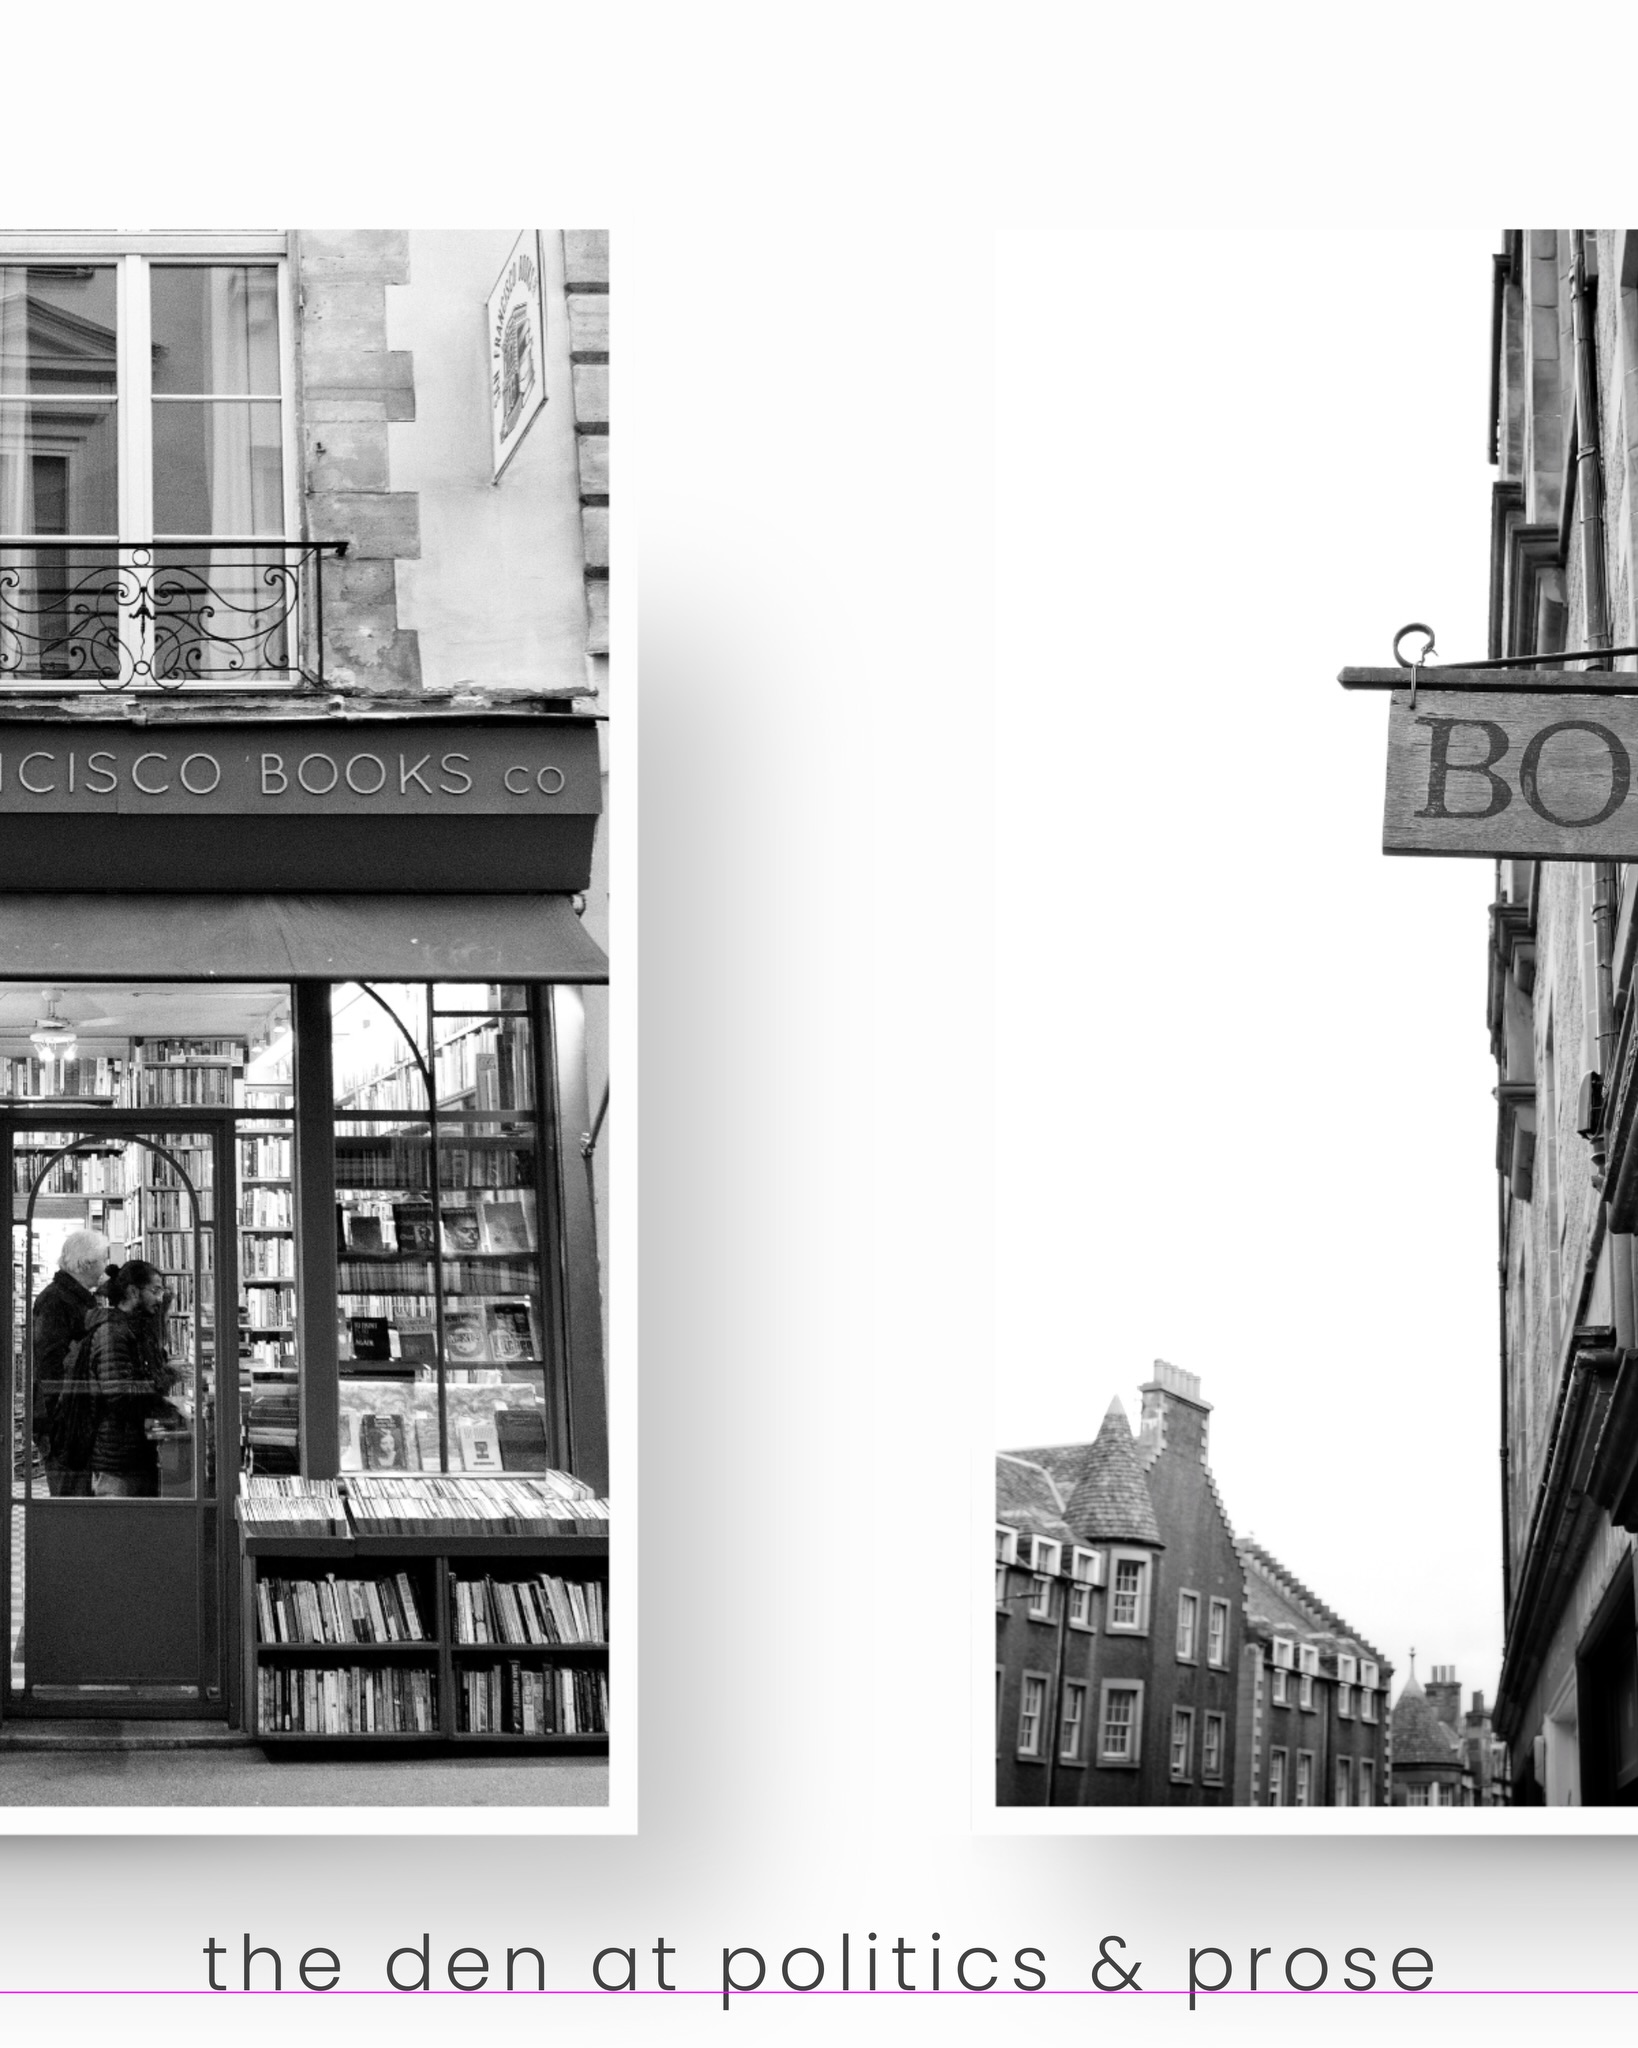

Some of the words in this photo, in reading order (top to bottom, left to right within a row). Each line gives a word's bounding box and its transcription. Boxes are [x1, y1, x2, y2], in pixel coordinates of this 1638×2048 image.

[0, 751, 221, 794] CISCO
[261, 752, 473, 794] BOOKS
[1413, 715, 1638, 828] BO
